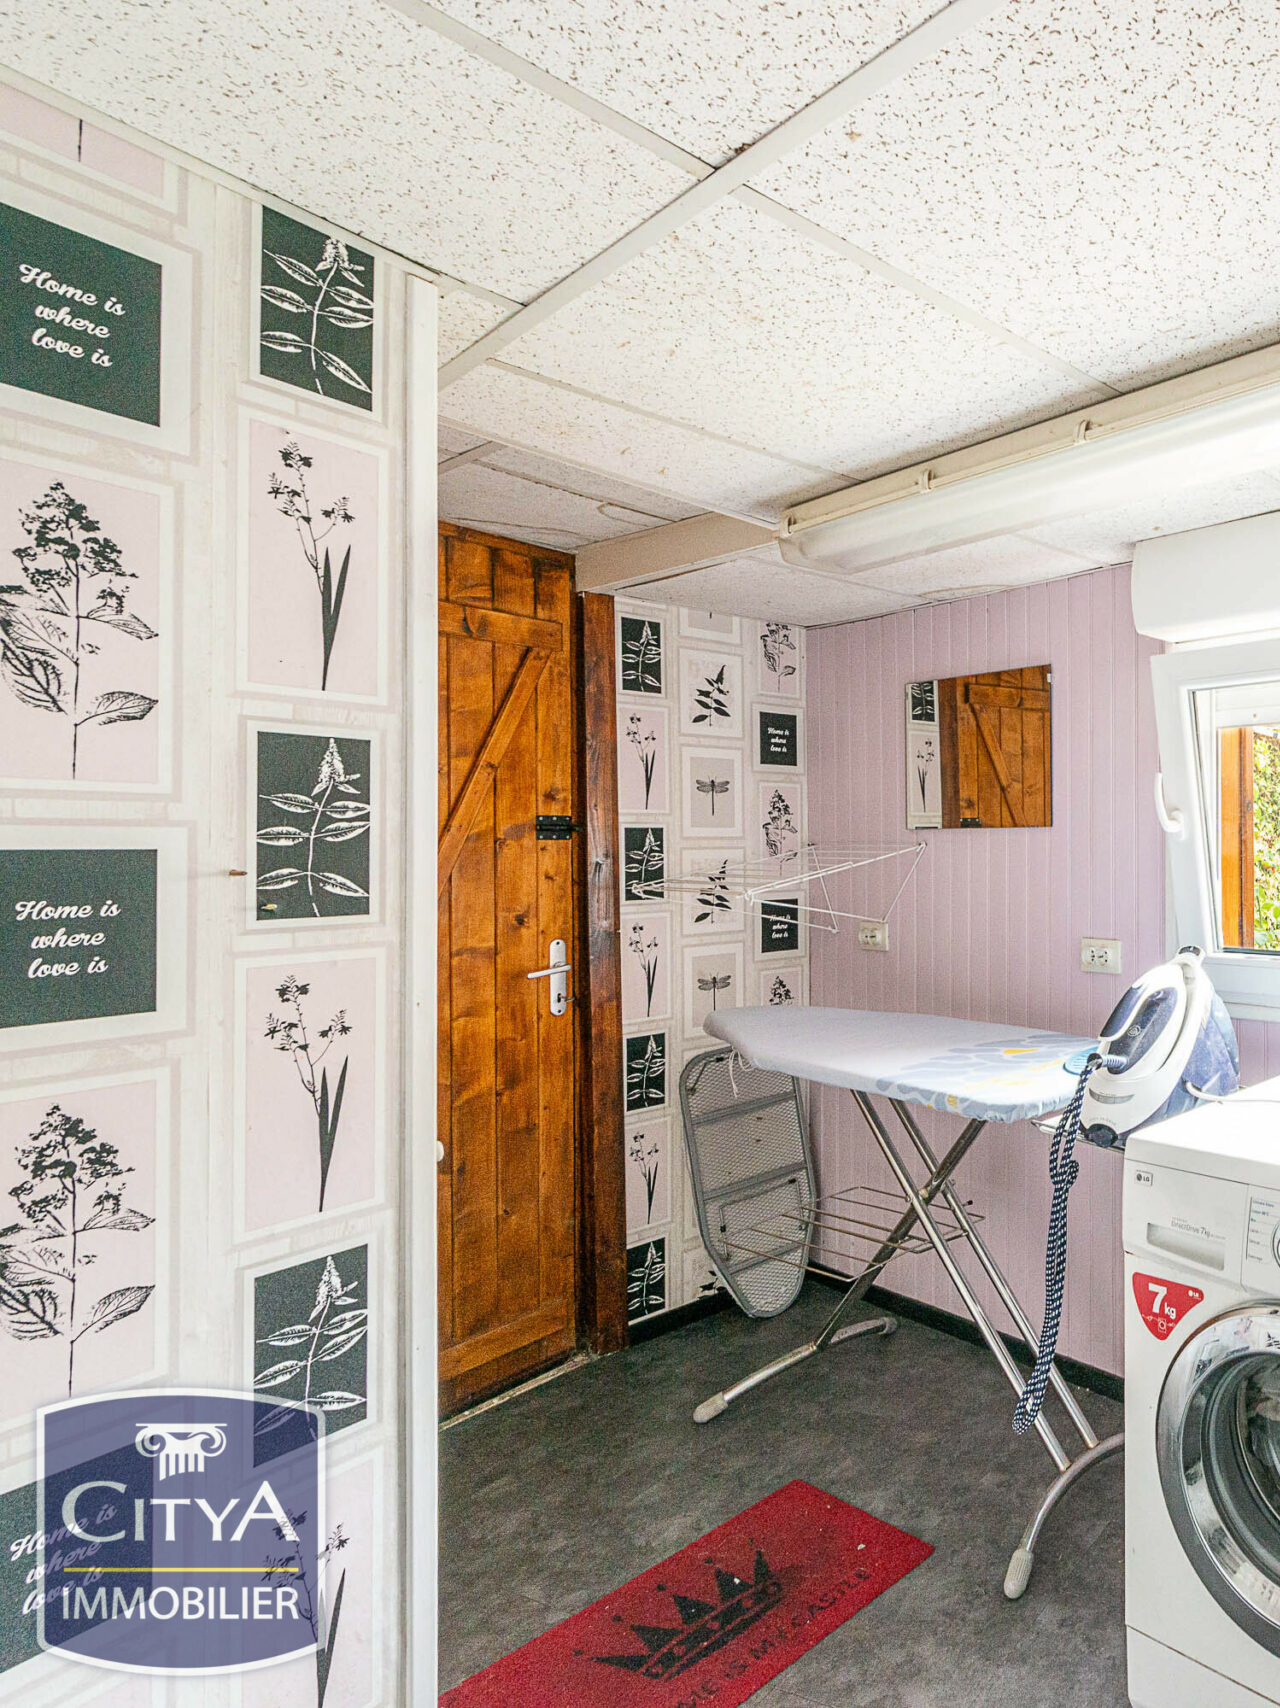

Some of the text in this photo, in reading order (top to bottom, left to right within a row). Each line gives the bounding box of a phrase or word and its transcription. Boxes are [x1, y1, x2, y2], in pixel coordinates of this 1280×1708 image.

[19, 263, 126, 316] Home is
[35, 305, 110, 338] where
[31, 327, 113, 367] love is
[15, 900, 122, 921] Home is
[31, 928, 106, 949] where
[28, 957, 109, 979] love is
[10, 1503, 118, 1561] Home is
[25, 1541, 102, 1584] where
[22, 1566, 104, 1615] love is
